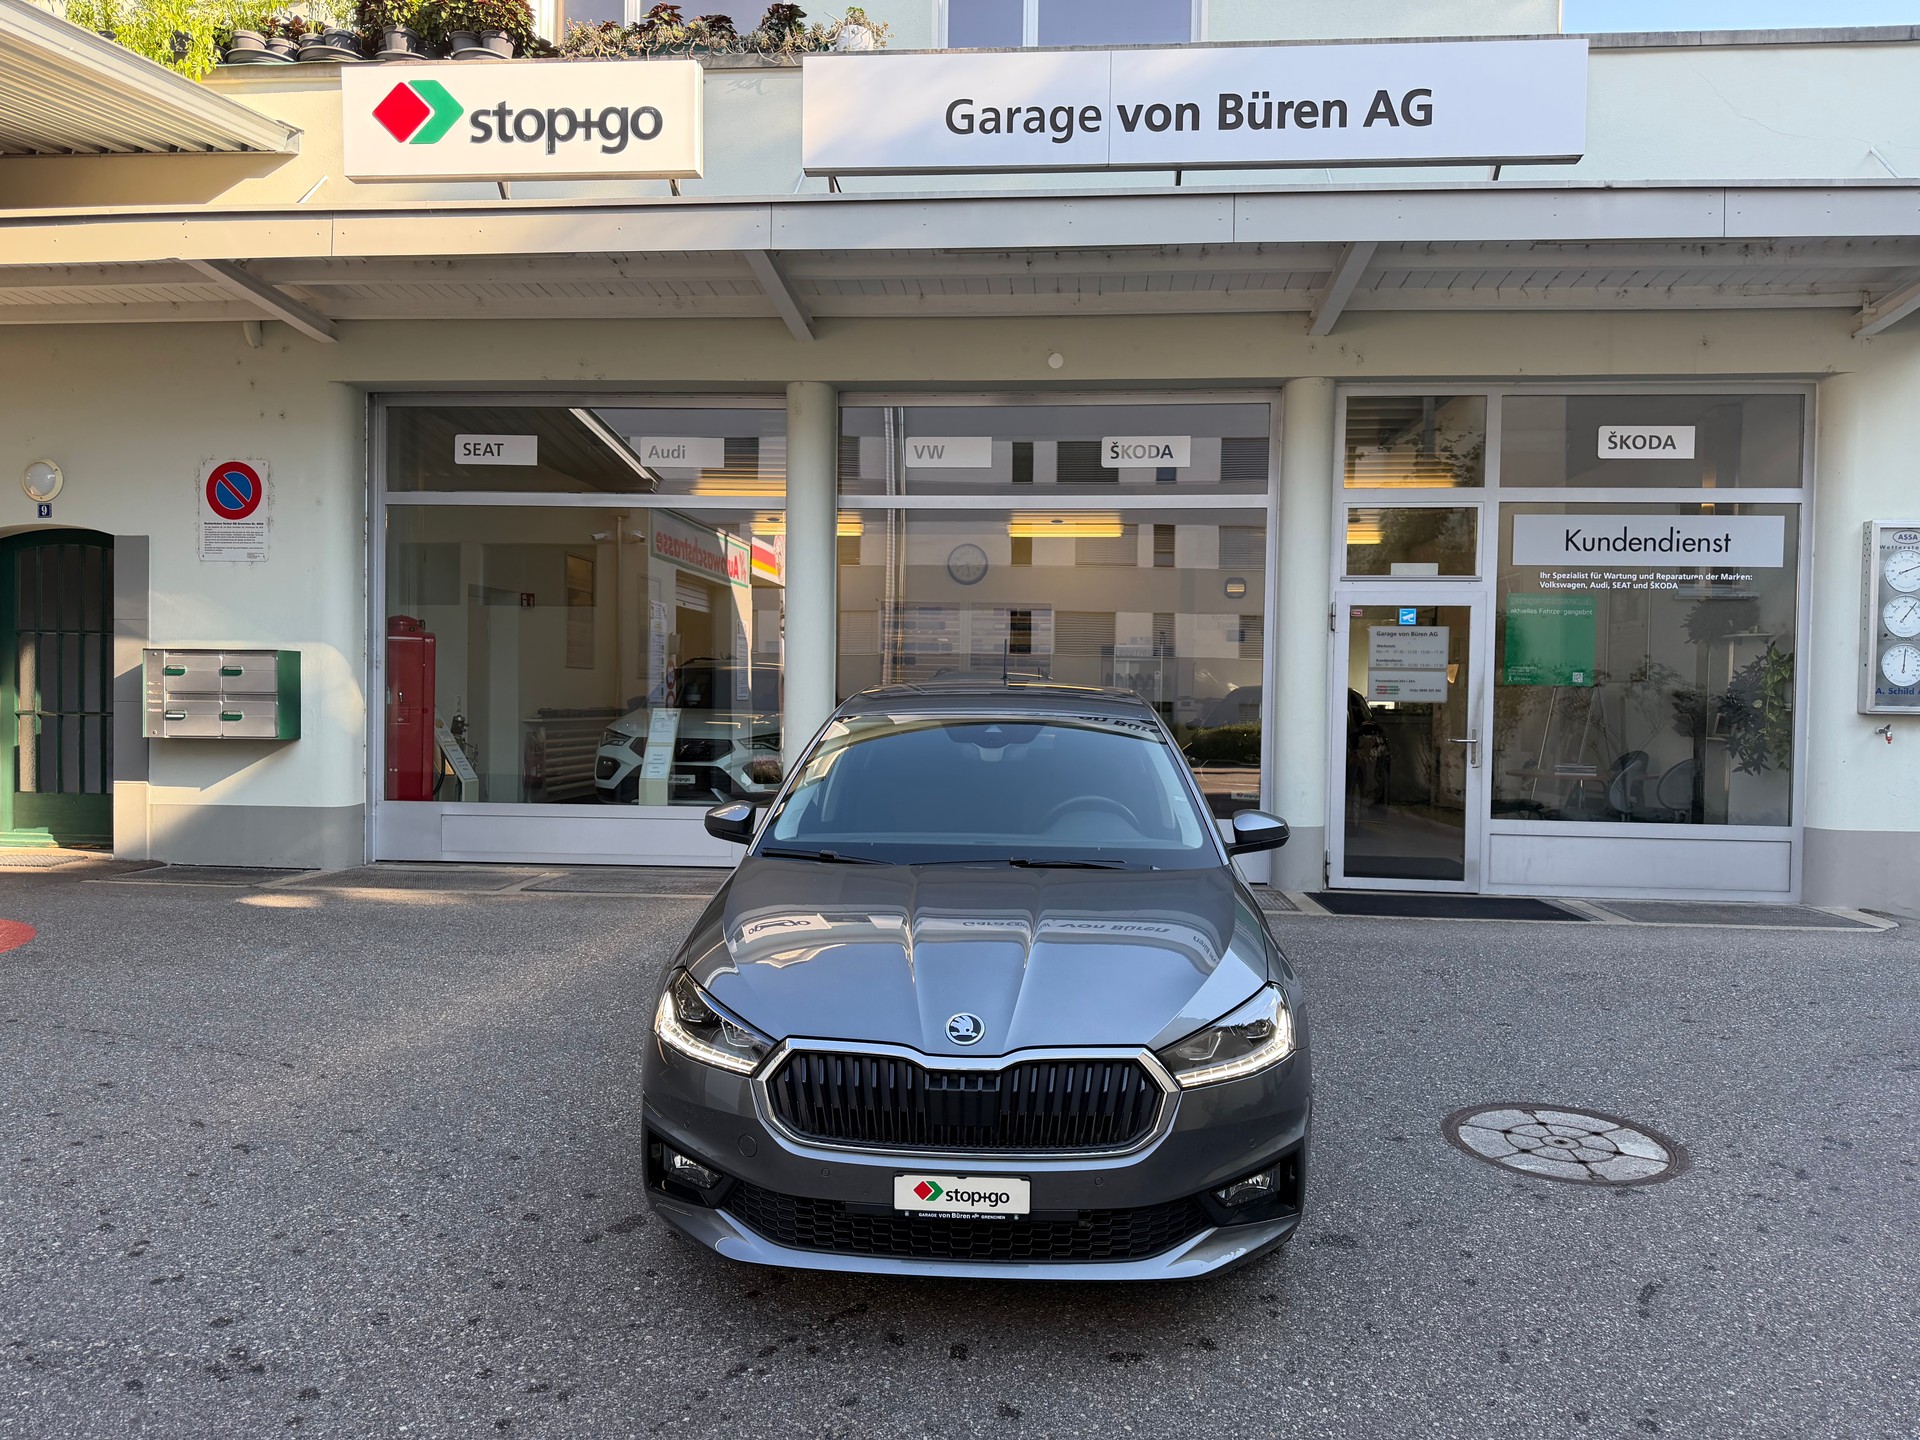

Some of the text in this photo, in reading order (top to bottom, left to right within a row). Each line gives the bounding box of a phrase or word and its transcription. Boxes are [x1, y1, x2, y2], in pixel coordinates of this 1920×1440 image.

[945, 88, 1433, 144] Garage von Büren AG
[470, 100, 663, 155] stop+go
[1608, 431, 1676, 450] ŠKODA
[463, 442, 504, 456] SEAT
[648, 445, 686, 459] Audi
[914, 445, 945, 459] VW
[1110, 442, 1174, 459] ŠKODA
[41, 505, 47, 516] 9
[1565, 526, 1731, 553] Kundendienst
[1552, 572, 1588, 580] Spezialist
[1650, 581, 1678, 589] ŠKODA
[945, 1188, 1010, 1207] stop+go
